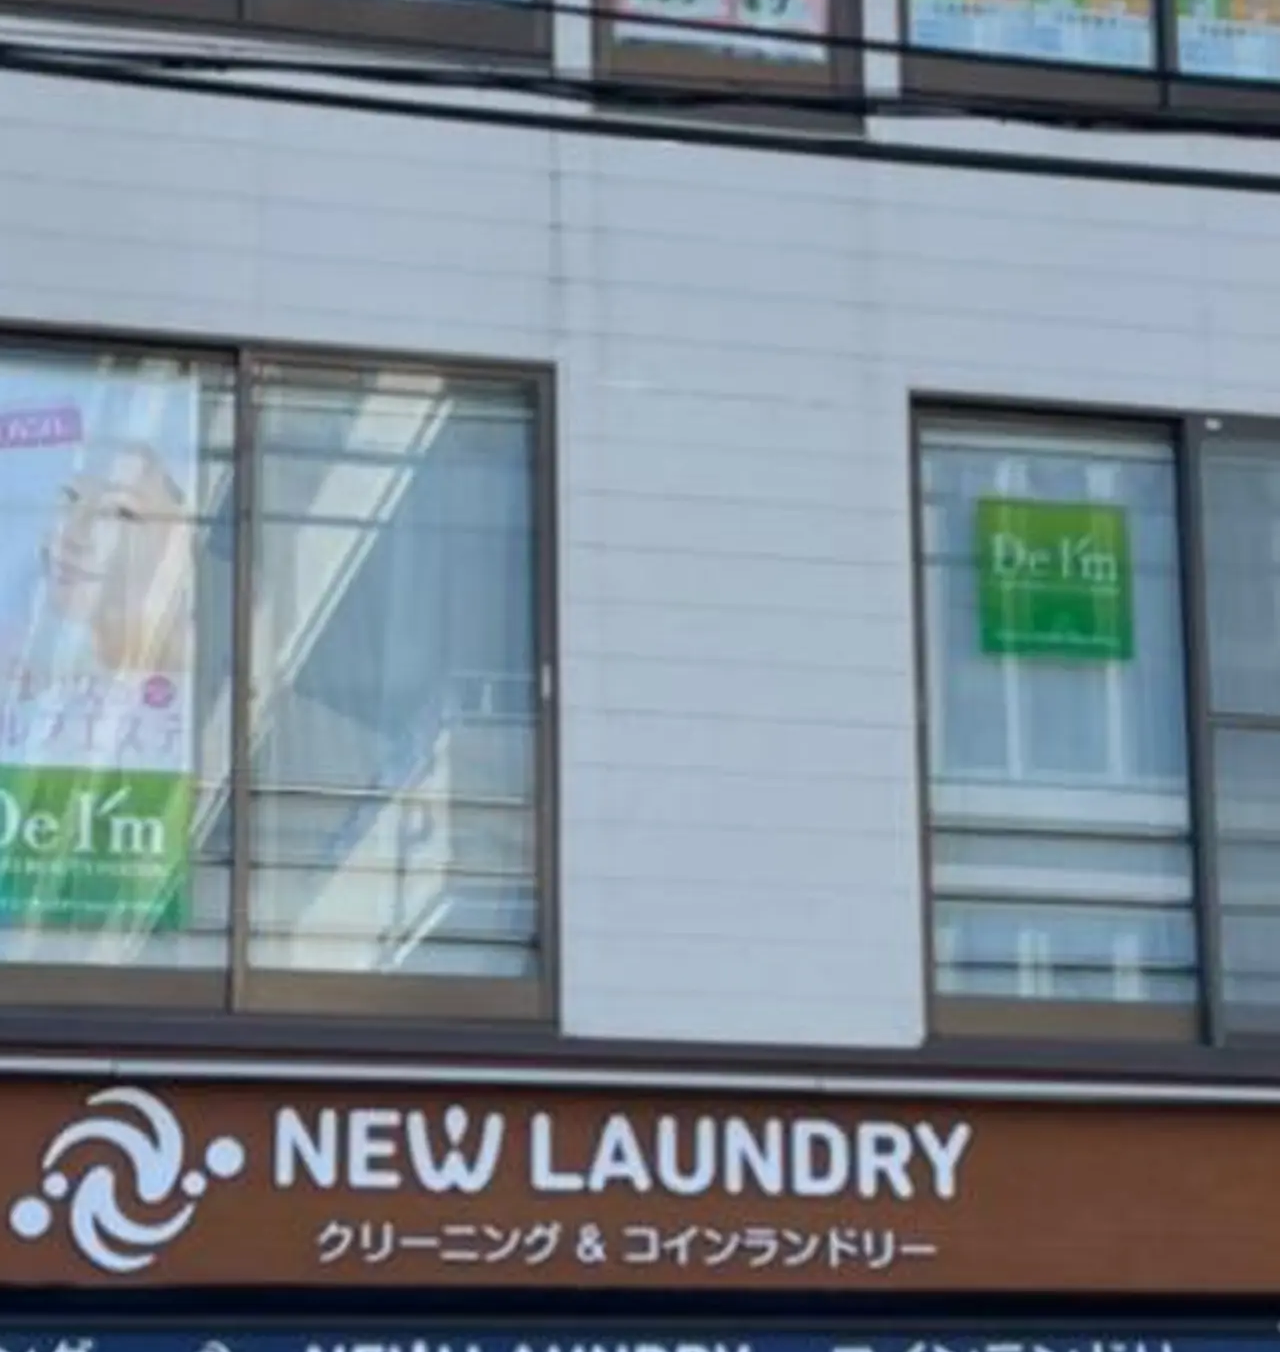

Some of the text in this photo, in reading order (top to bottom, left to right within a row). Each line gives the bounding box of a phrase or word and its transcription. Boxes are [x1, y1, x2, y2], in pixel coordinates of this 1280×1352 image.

[275, 1105, 971, 1199] NEW LAUNDRY
[317, 1221, 938, 1268] クリーニング & コインランドリー
